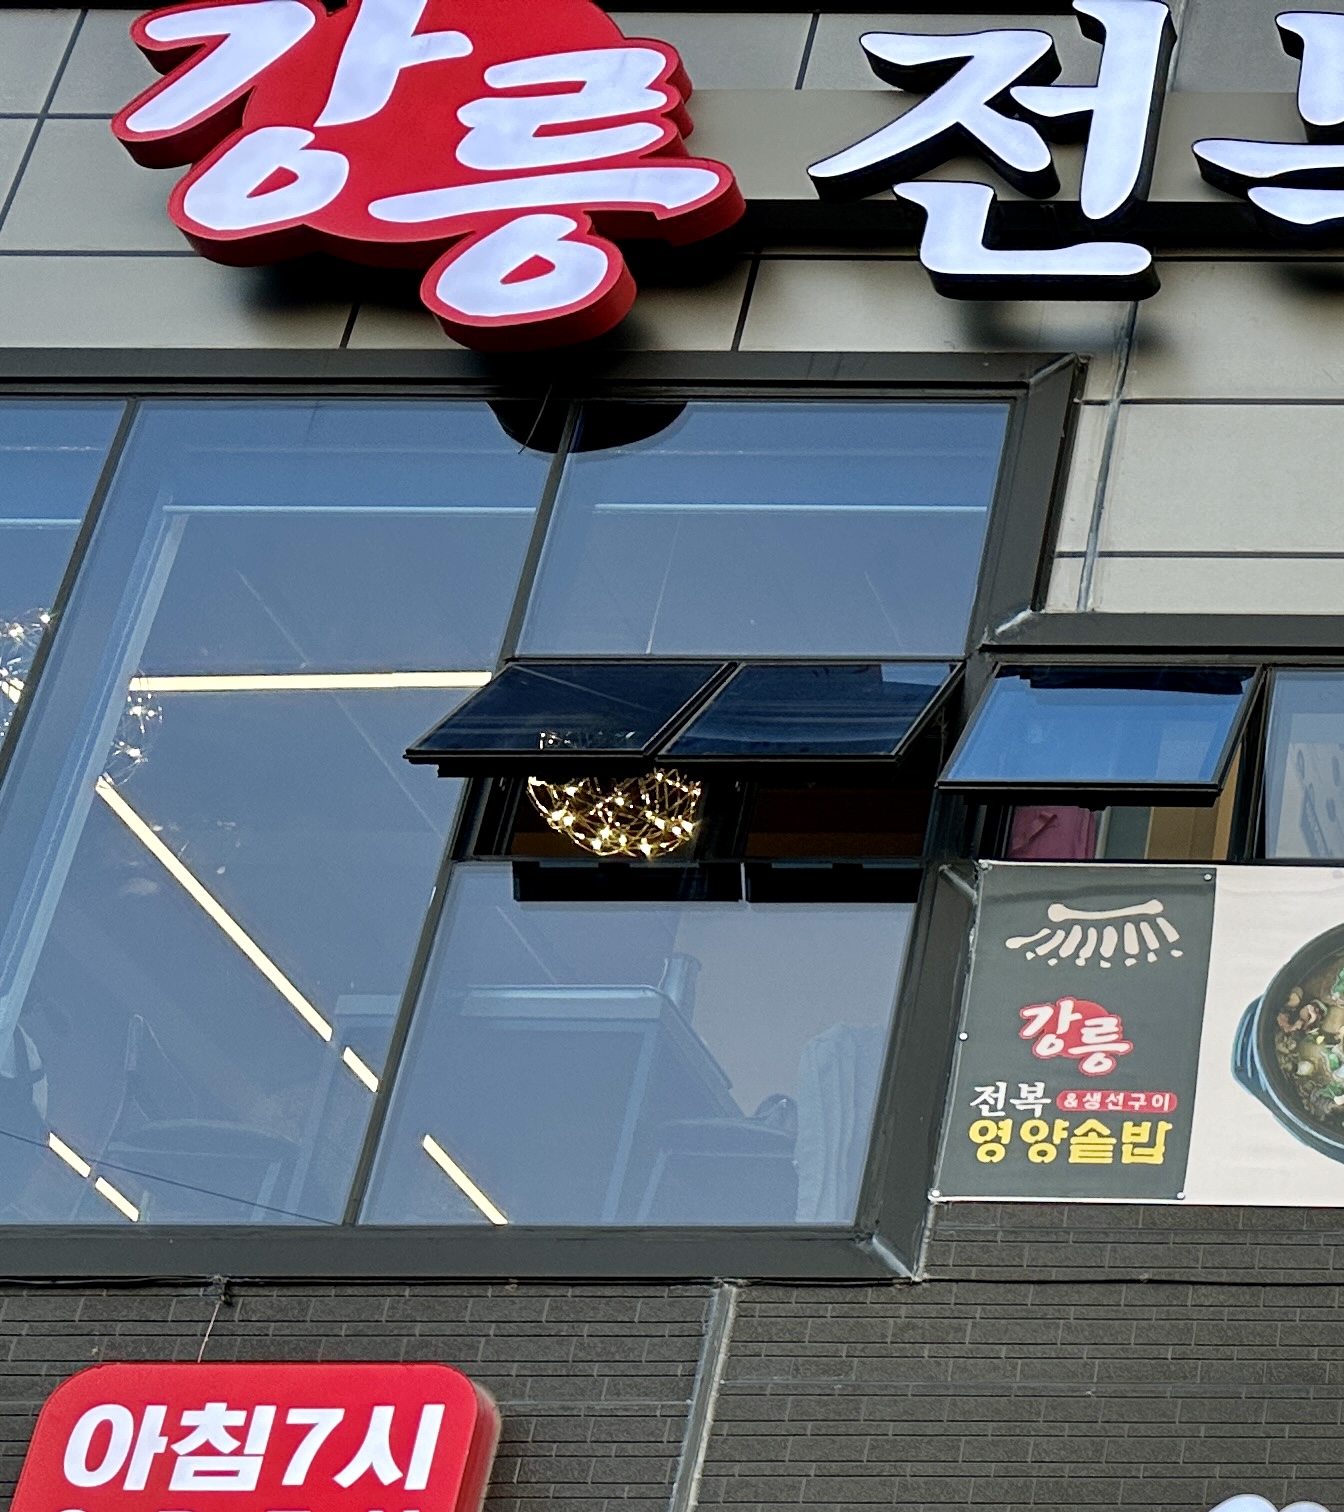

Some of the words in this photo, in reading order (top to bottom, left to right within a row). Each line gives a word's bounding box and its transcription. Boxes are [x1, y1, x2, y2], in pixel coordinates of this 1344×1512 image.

[124, 0, 722, 317] 강릉
[1020, 998, 1132, 1075] 강릉
[970, 1082, 1051, 1117] 전복
[969, 1119, 1172, 1164] 영양솥밥
[63, 1402, 446, 1491] 아침7시
